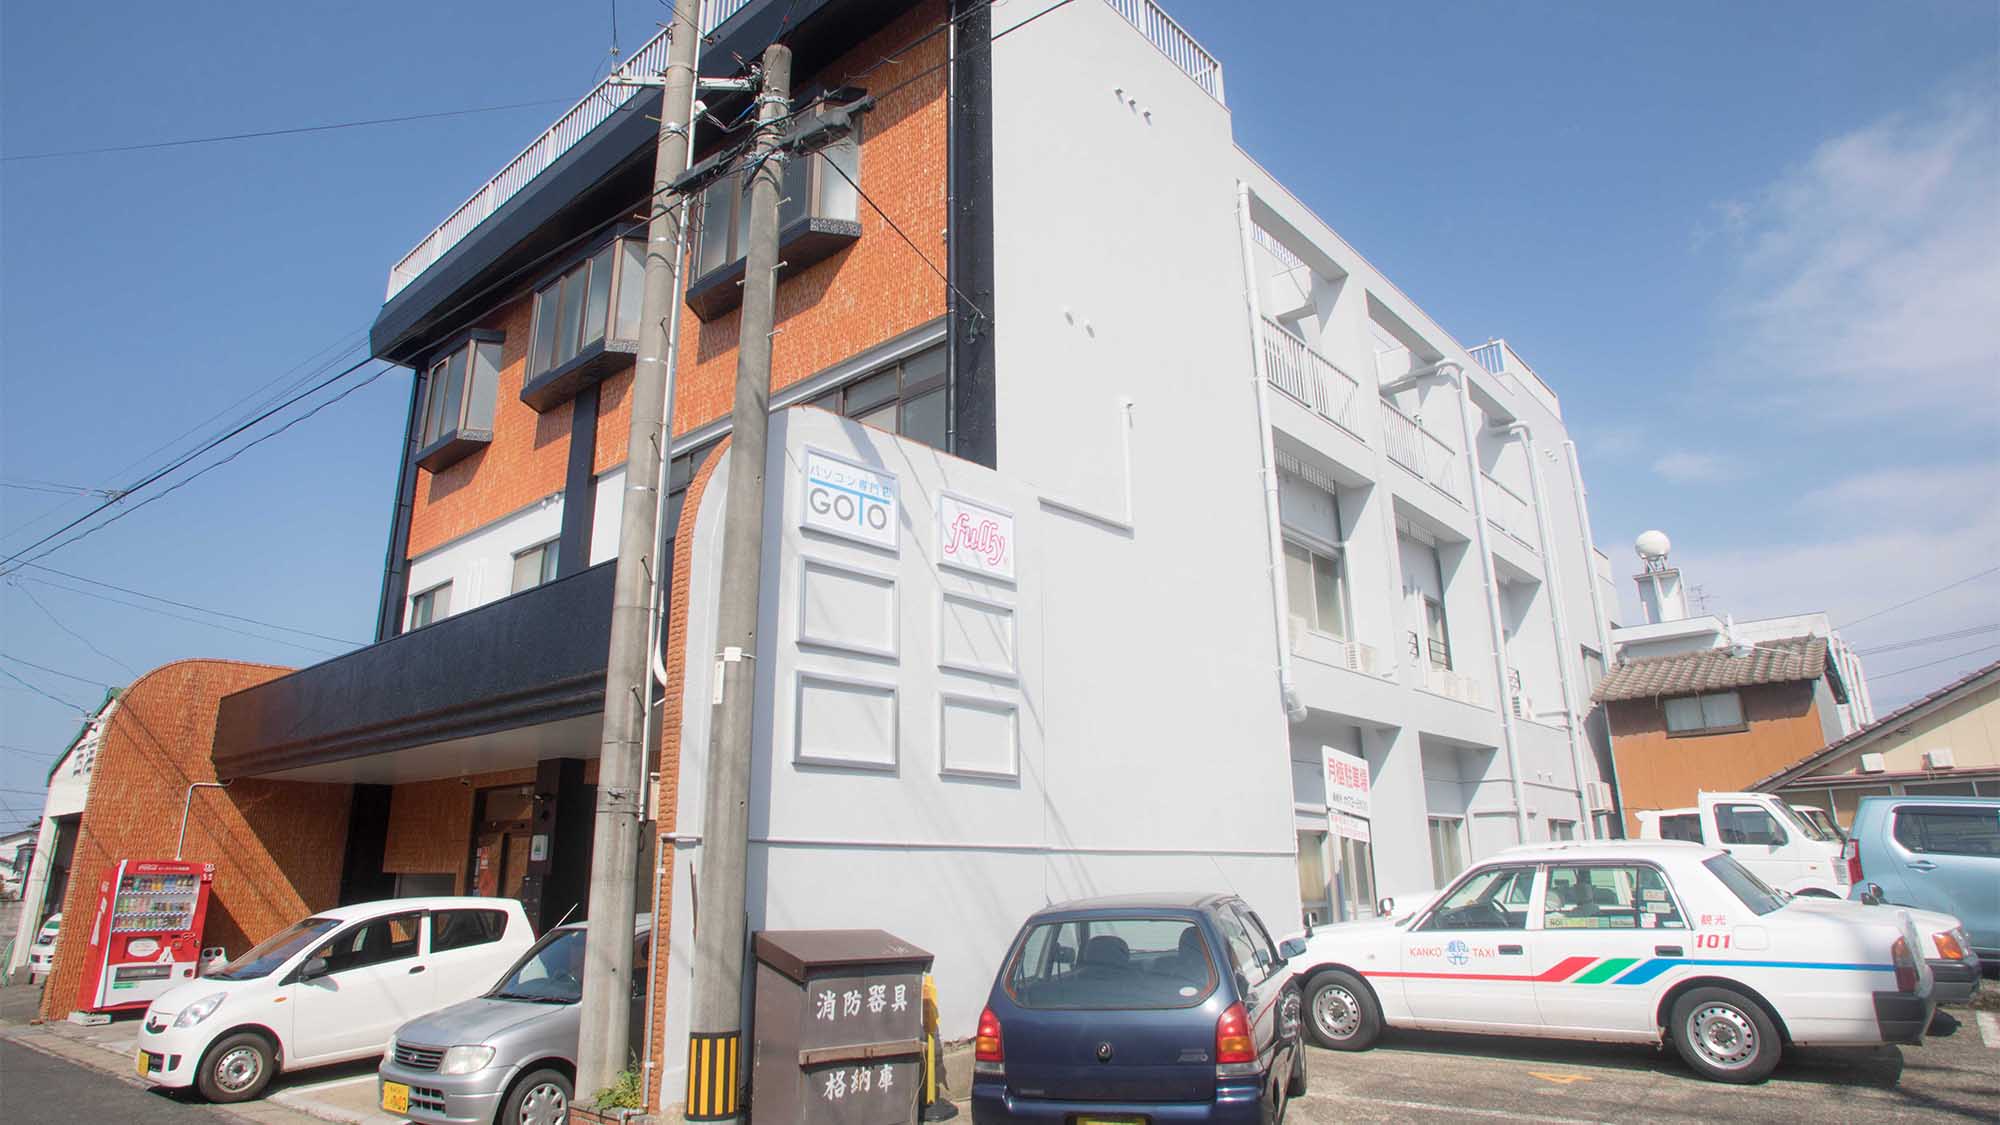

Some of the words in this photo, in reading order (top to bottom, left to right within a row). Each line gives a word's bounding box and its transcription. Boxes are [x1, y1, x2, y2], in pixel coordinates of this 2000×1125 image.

[809, 482, 889, 530] GOTO
[944, 512, 1006, 566] fully
[1408, 947, 1442, 958] KANKO
[1471, 947, 1496, 958] TAXI
[1696, 933, 1731, 949] 101
[816, 983, 909, 1022] 消防器具
[823, 1064, 895, 1101] 格納庫
